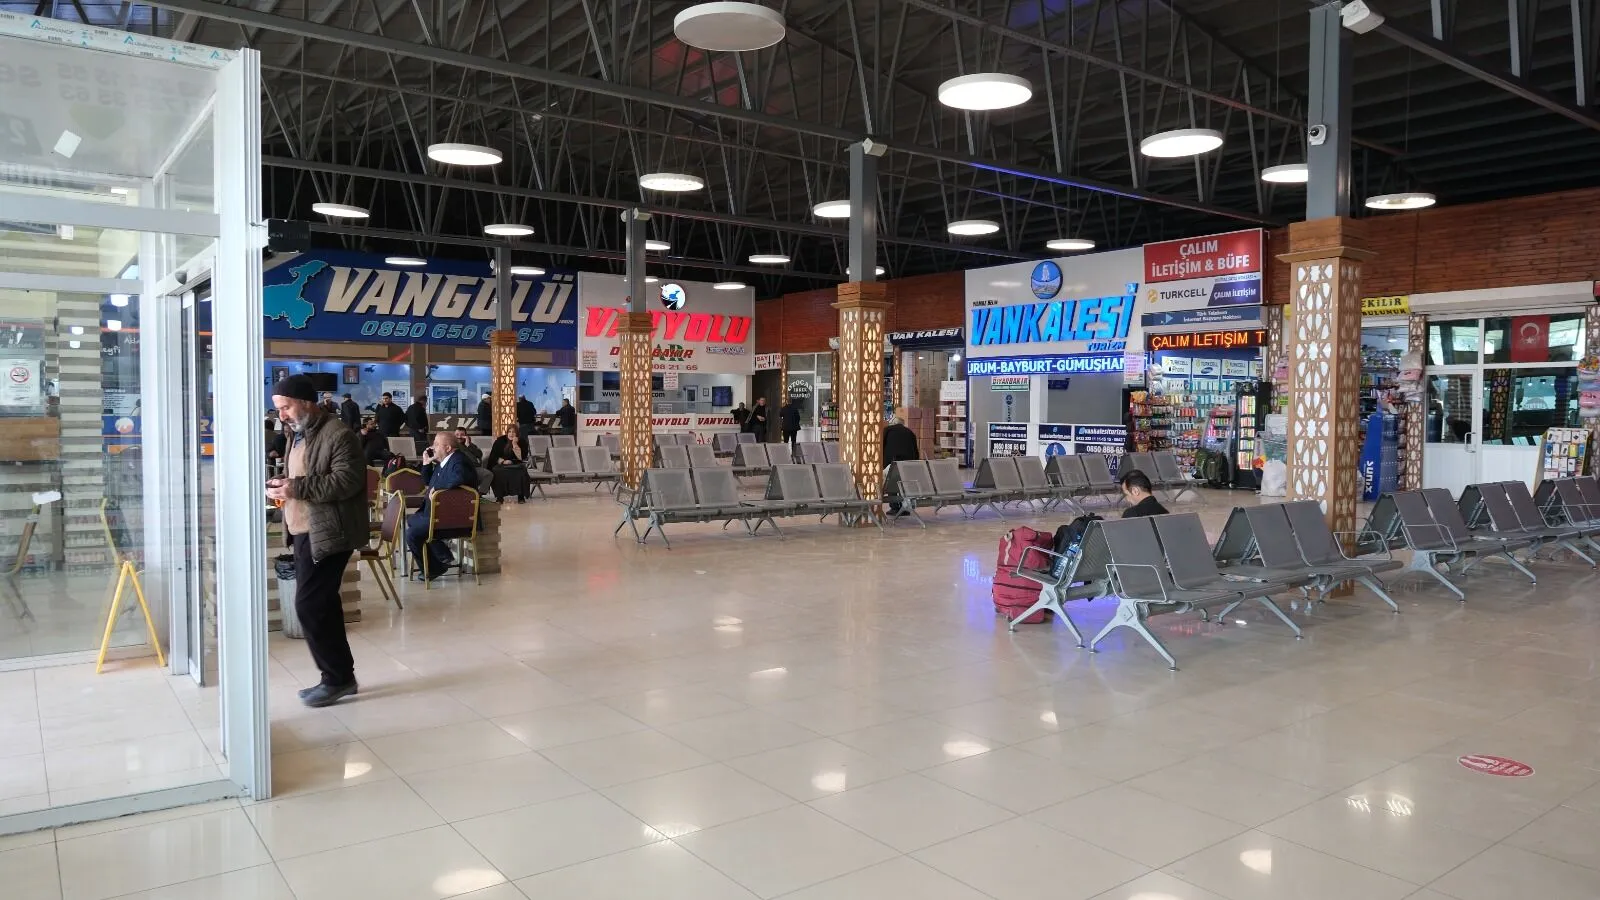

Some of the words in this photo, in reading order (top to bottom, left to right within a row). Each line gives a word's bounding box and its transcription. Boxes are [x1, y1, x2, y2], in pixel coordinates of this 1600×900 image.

[1179, 240, 1218, 259] ÇALIM
[1151, 259, 1201, 278] İLETİŞİM
[1204, 259, 1214, 272] &
[1217, 254, 1250, 270] BÜFE
[1160, 288, 1207, 300] TURKCELL
[1214, 291, 1231, 300] ÇALIM
[1232, 287, 1256, 298] İLETİŞİM
[970, 283, 1139, 347] VANKALESİ
[361, 320, 427, 338] 0850
[431, 323, 477, 340] 650
[892, 332, 914, 340] VAN
[1087, 340, 1127, 351] TURİZM
[1152, 335, 1190, 350] ÇALIM
[1193, 331, 1248, 347] İLETİŞİM
[1255, 331, 1265, 343] T
[585, 418, 621, 427] VANYO
